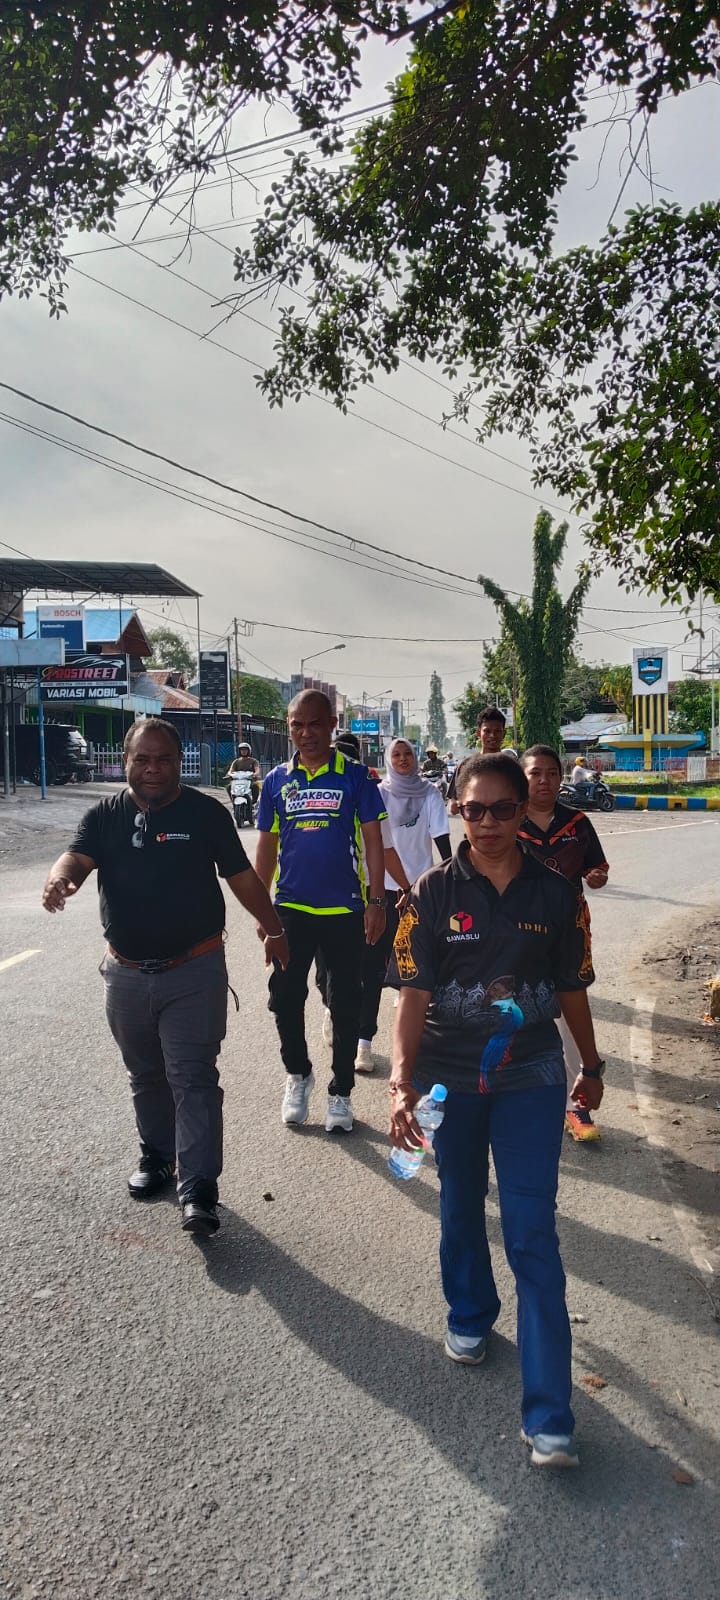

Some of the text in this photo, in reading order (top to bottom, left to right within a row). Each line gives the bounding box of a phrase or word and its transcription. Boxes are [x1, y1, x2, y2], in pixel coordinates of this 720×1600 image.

[53, 609, 81, 617] BOSCH
[47, 687, 119, 699] VARIASI MOBIL
[290, 791, 341, 803] MAKBON
[446, 933, 480, 943] BAWASLU
